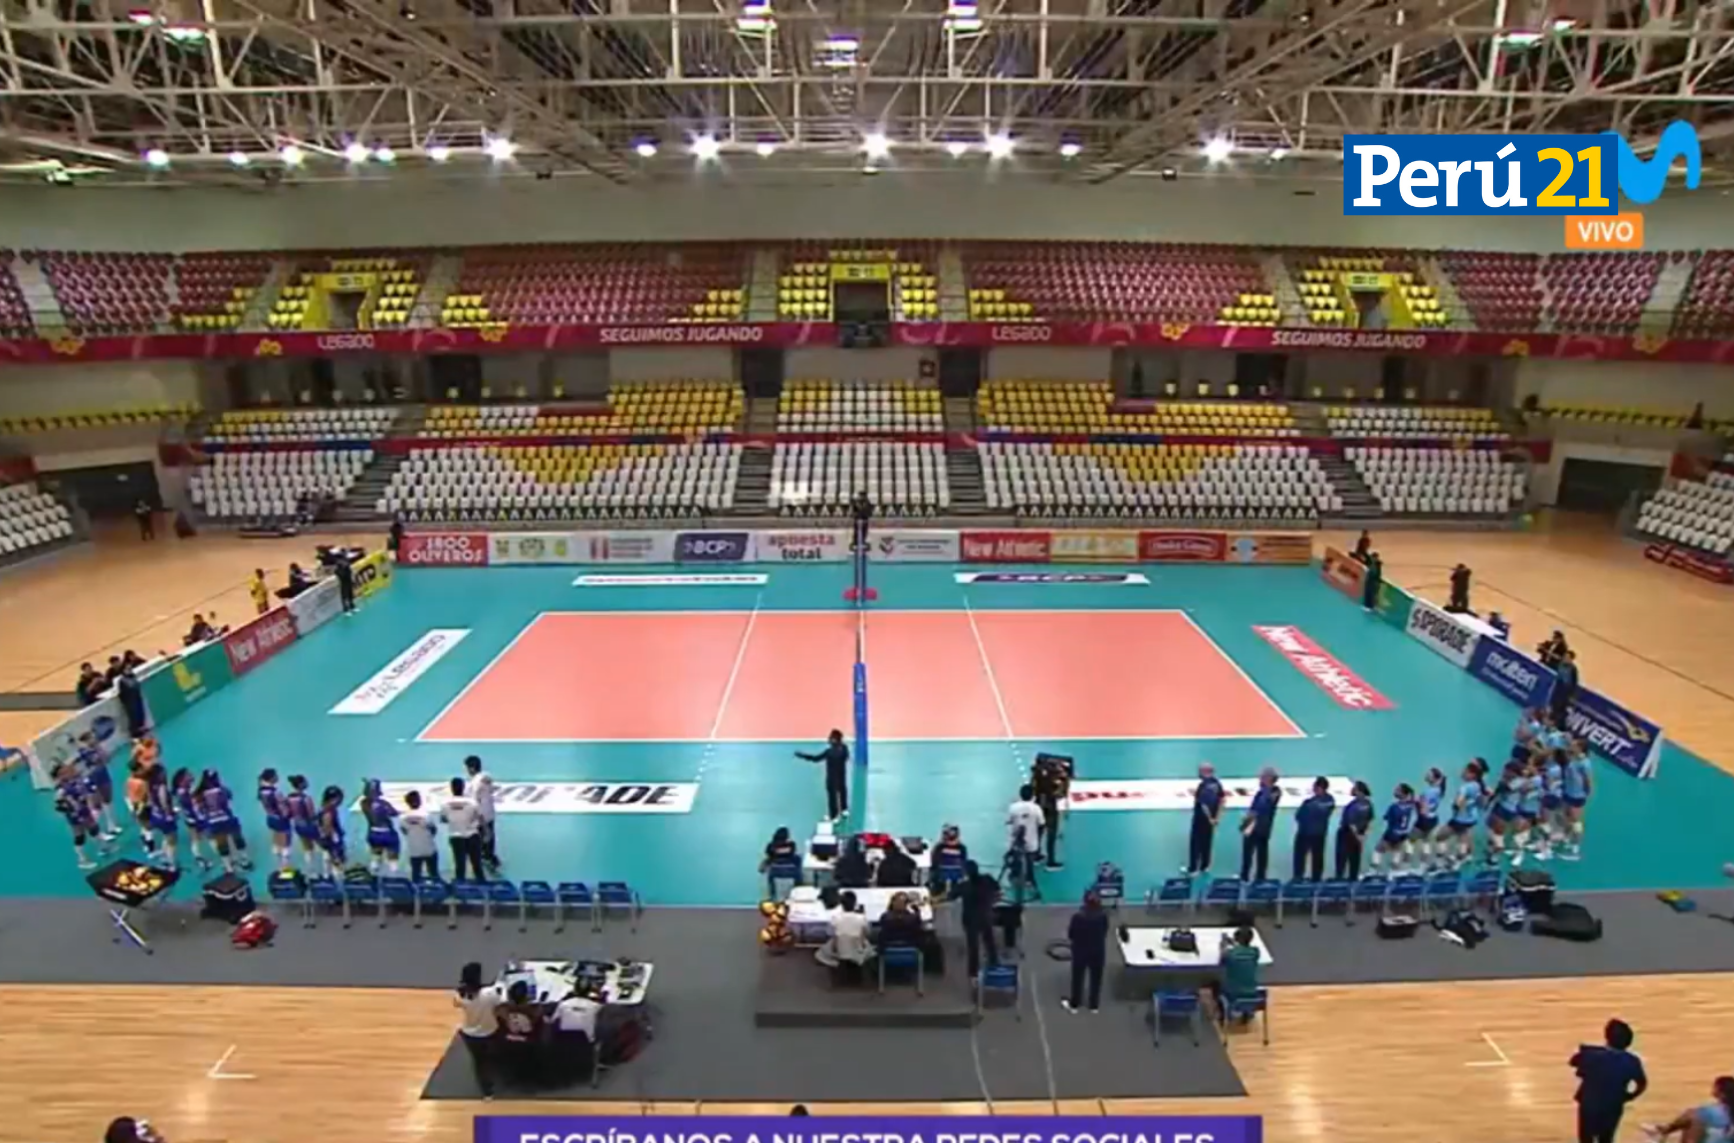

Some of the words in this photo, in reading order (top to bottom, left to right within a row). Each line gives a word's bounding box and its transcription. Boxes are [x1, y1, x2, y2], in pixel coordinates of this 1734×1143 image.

[600, 327, 684, 343] SEGUIMOS
[687, 326, 763, 342] JUGANDO
[1272, 331, 1351, 347] SEGUIMOS
[1352, 333, 1427, 349] JUGANDO
[781, 547, 823, 560] total
